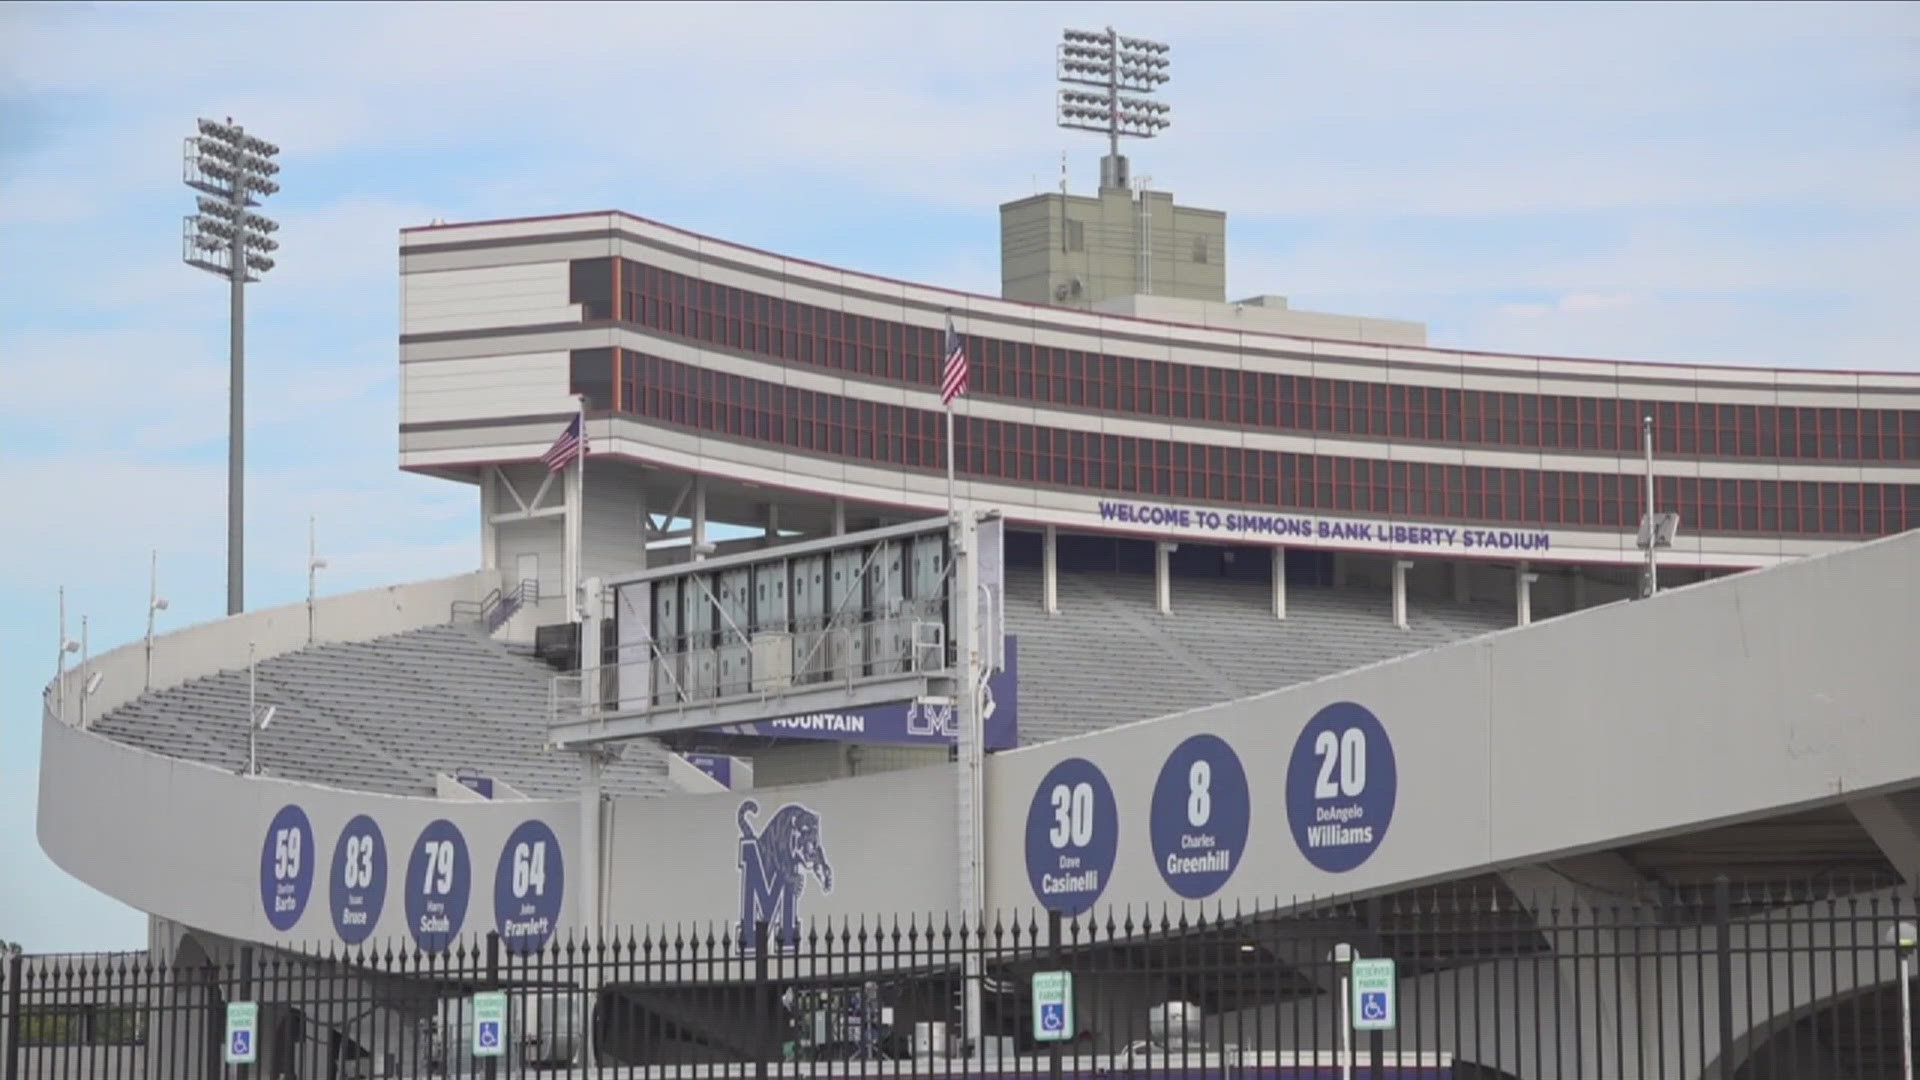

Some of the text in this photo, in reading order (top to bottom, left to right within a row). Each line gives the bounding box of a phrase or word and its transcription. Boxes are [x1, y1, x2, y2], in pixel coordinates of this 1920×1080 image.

[1099, 502, 1549, 551] WELCOME TO SIMMONS BANK LIBERTY STADIUM
[1314, 727, 1366, 800] 20
[1187, 760, 1211, 827] 8
[1049, 782, 1094, 849] 30
[1316, 804, 1363, 823] DeAngelo
[1181, 833, 1215, 849] Charles
[1307, 825, 1373, 847] Williams
[275, 827, 301, 880] 59
[344, 834, 373, 889] 83
[1059, 855, 1080, 869] Dave
[1166, 849, 1229, 875] Greenhill
[422, 840, 454, 895] 79
[512, 841, 546, 899] 64
[1042, 871, 1098, 895] Casinelli
[342, 908, 367, 925] Bruce
[427, 900, 445, 915] Harry
[420, 914, 450, 933] Schuh
